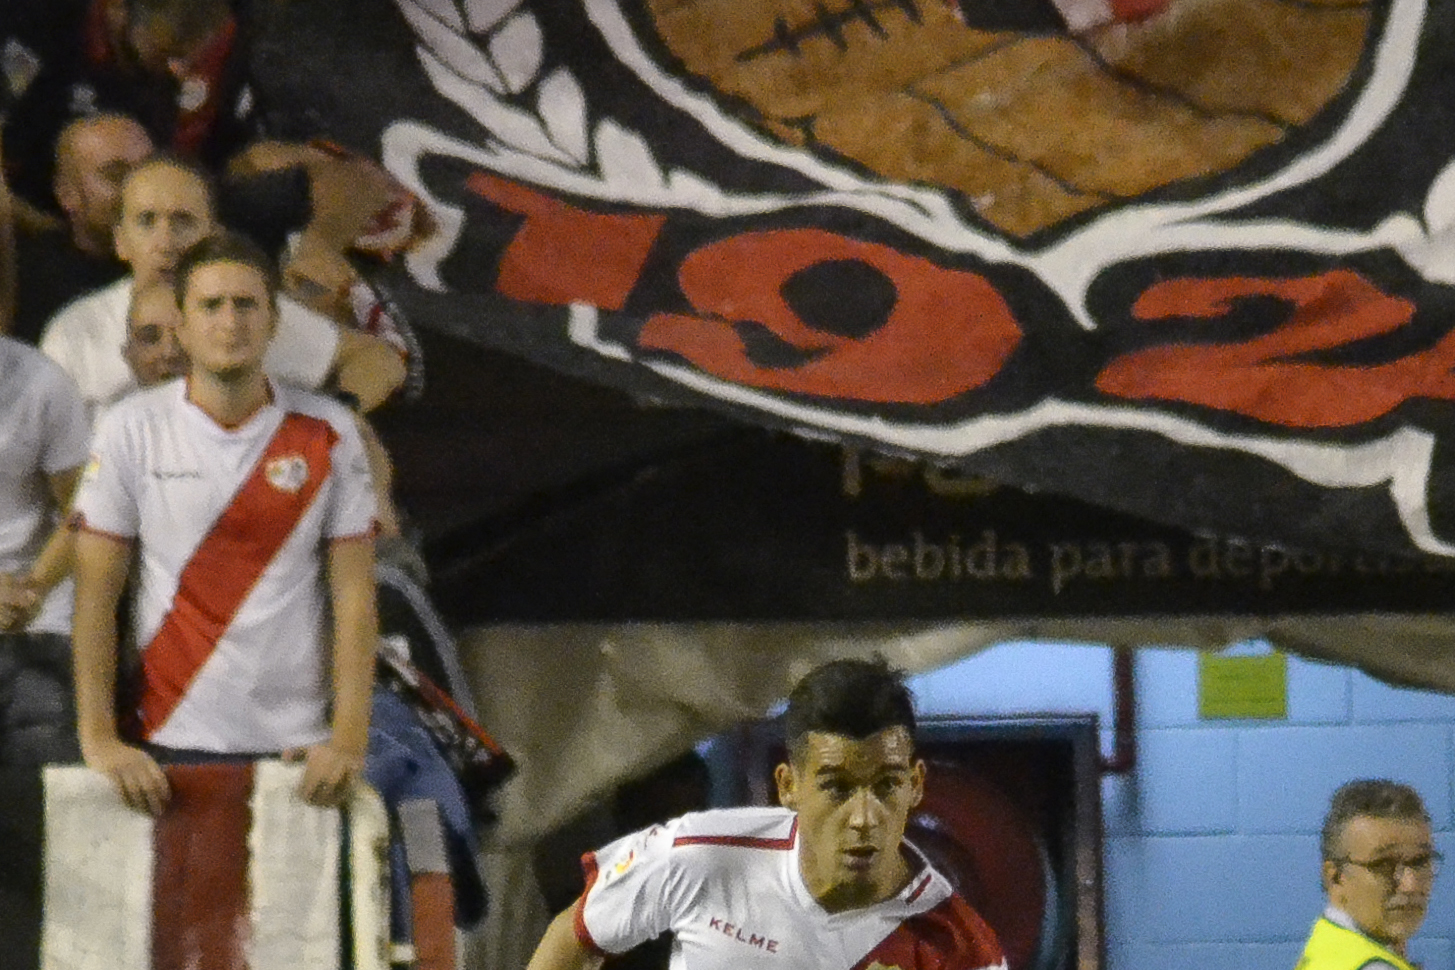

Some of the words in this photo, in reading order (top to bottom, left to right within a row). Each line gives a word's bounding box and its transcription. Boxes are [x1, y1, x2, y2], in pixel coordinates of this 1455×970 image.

[845, 529, 1030, 580] bebida
[1050, 542, 1171, 595] para
[708, 915, 780, 954] KELME
